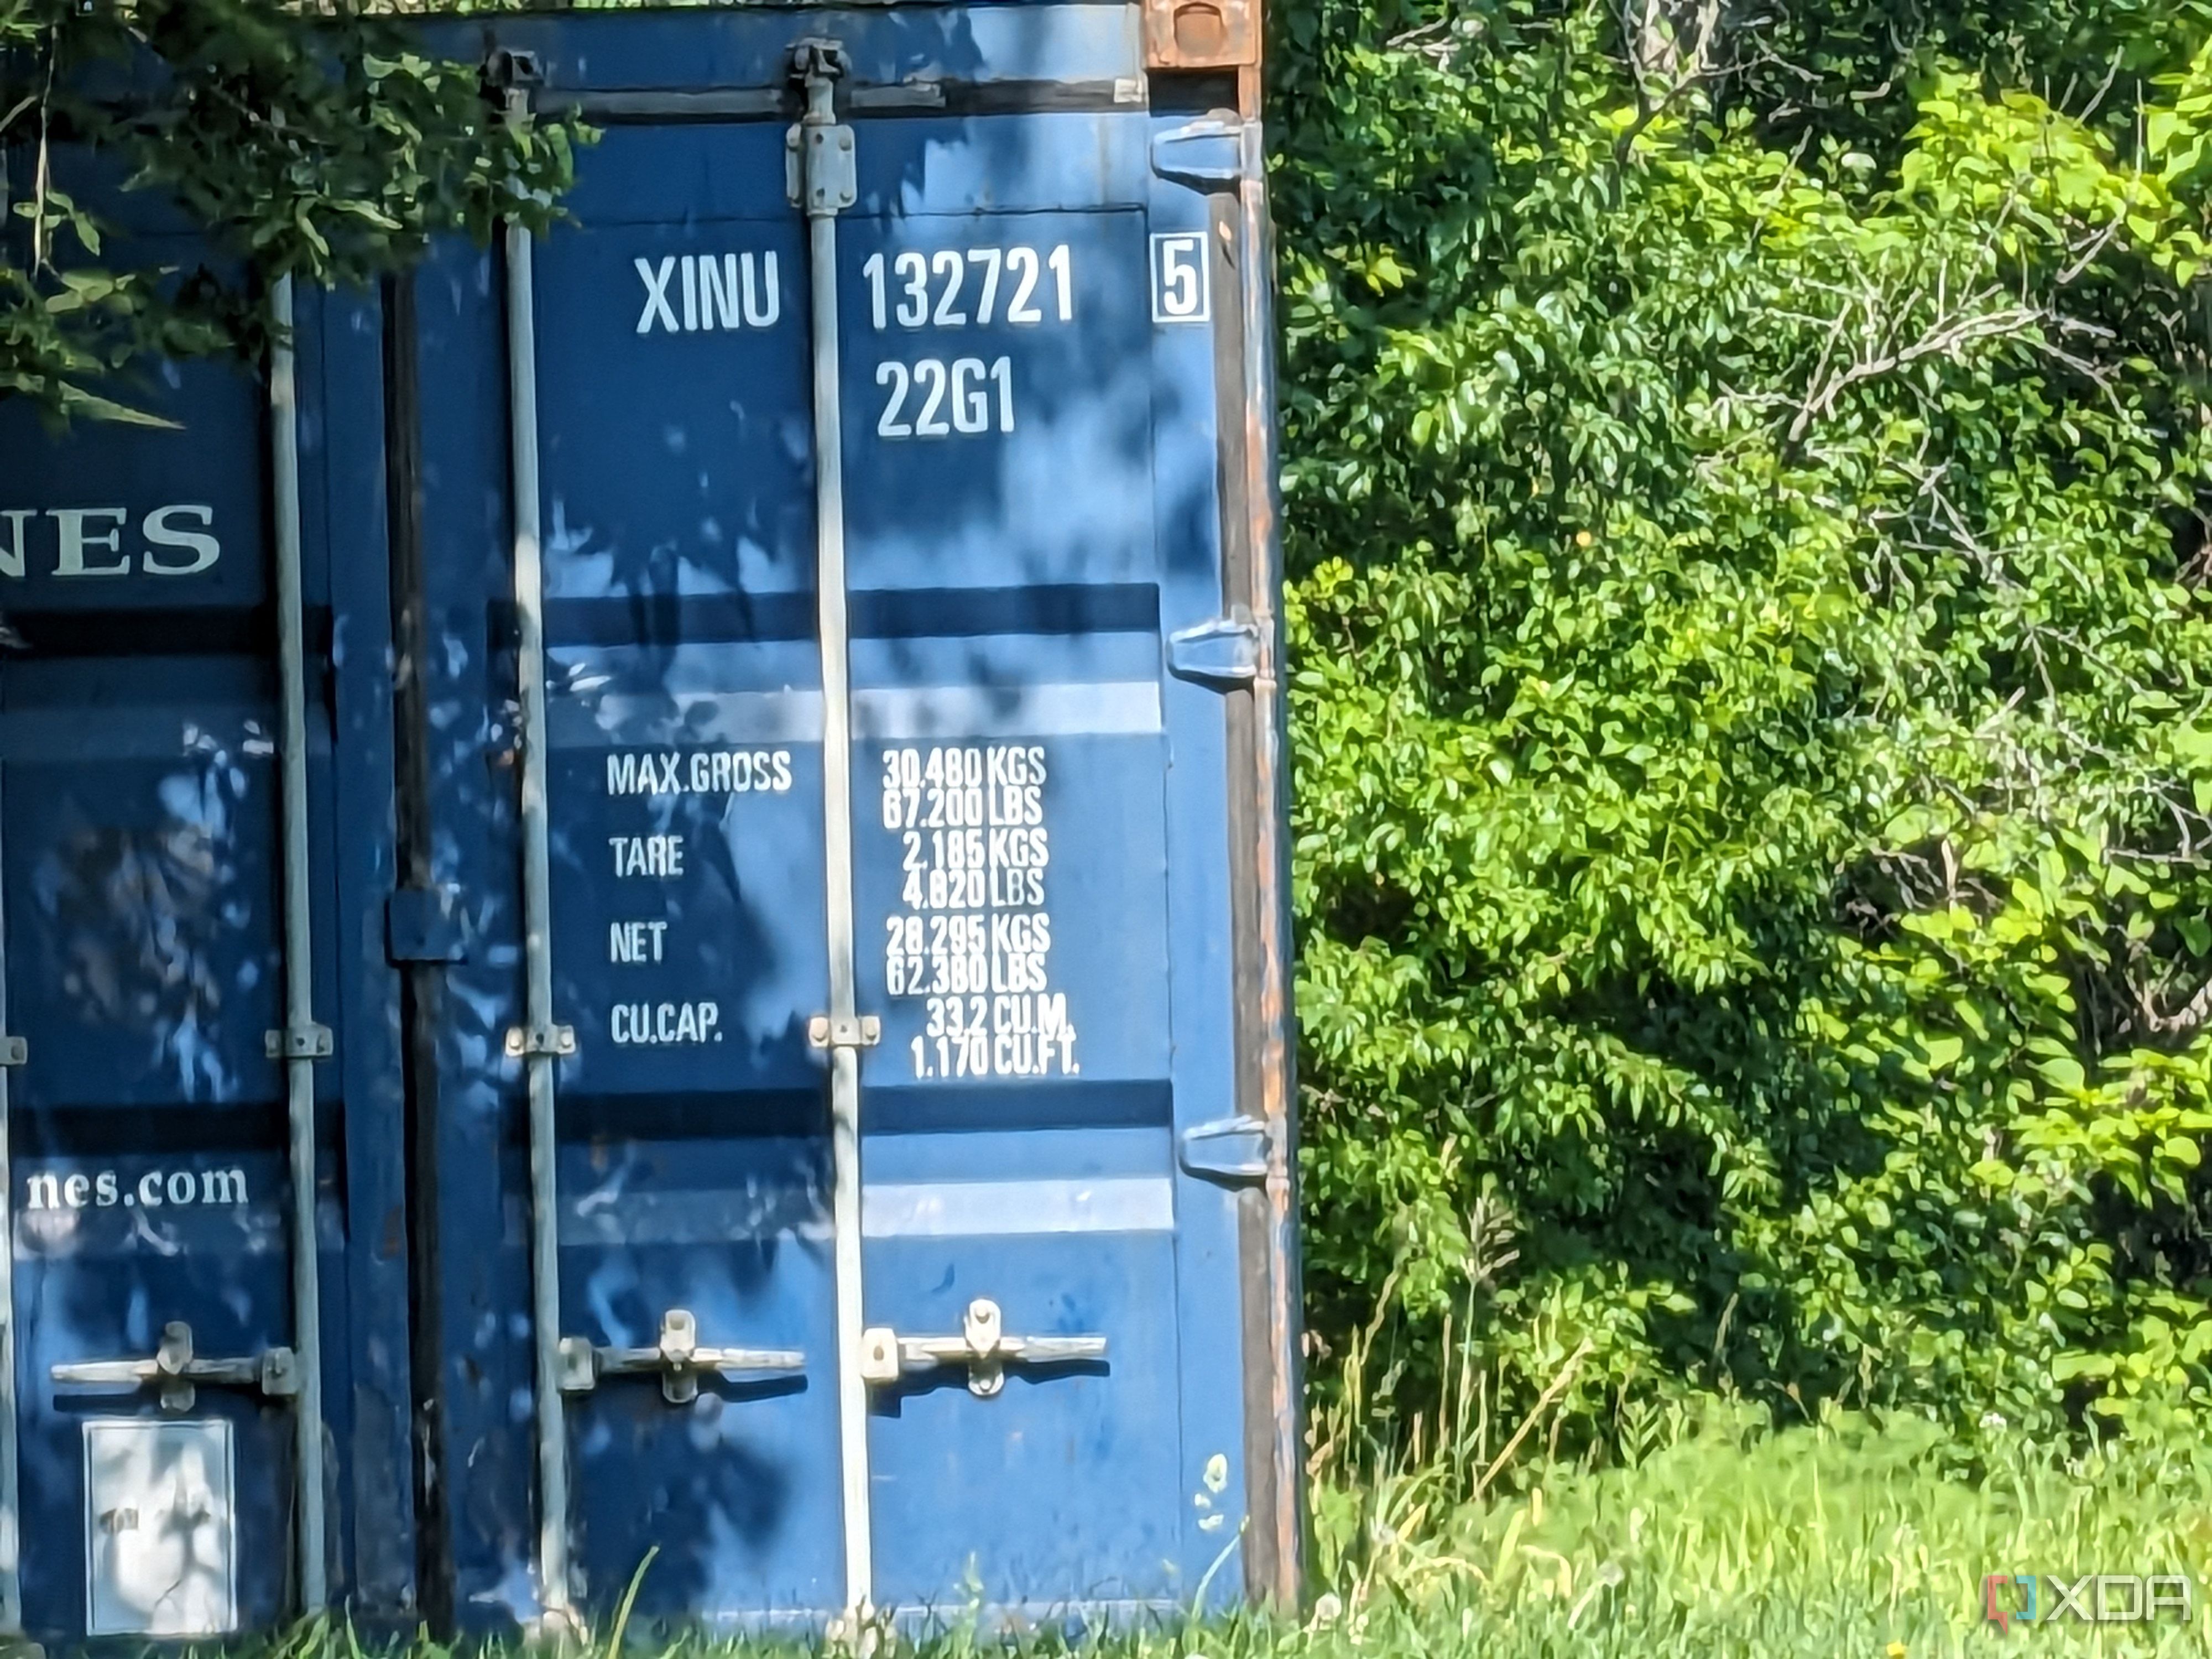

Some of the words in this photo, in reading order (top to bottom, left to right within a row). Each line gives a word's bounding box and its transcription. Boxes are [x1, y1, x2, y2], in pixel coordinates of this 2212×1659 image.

[634, 250, 781, 333] XINU
[863, 244, 1072, 329] 132721
[1162, 239, 1198, 315] 5
[876, 357, 1015, 436] 22G1
[607, 750, 792, 795] MAX.GROSS
[883, 747, 983, 789] 30.480
[987, 746, 1047, 786] KGS
[883, 787, 983, 828] 67.200
[988, 785, 1043, 826] LBS
[608, 834, 684, 877] TARE
[903, 829, 985, 871] 2.185
[989, 827, 1049, 868] KGS
[990, 868, 1045, 907] LBS
[610, 921, 668, 963] NET
[886, 915, 986, 956] 28.295
[992, 912, 1051, 953] KGS
[886, 954, 988, 995] 62.380
[992, 952, 1048, 993] LBS
[611, 1001, 723, 1044] CU.CAP.
[995, 1033, 1079, 1074] CU.FT.
